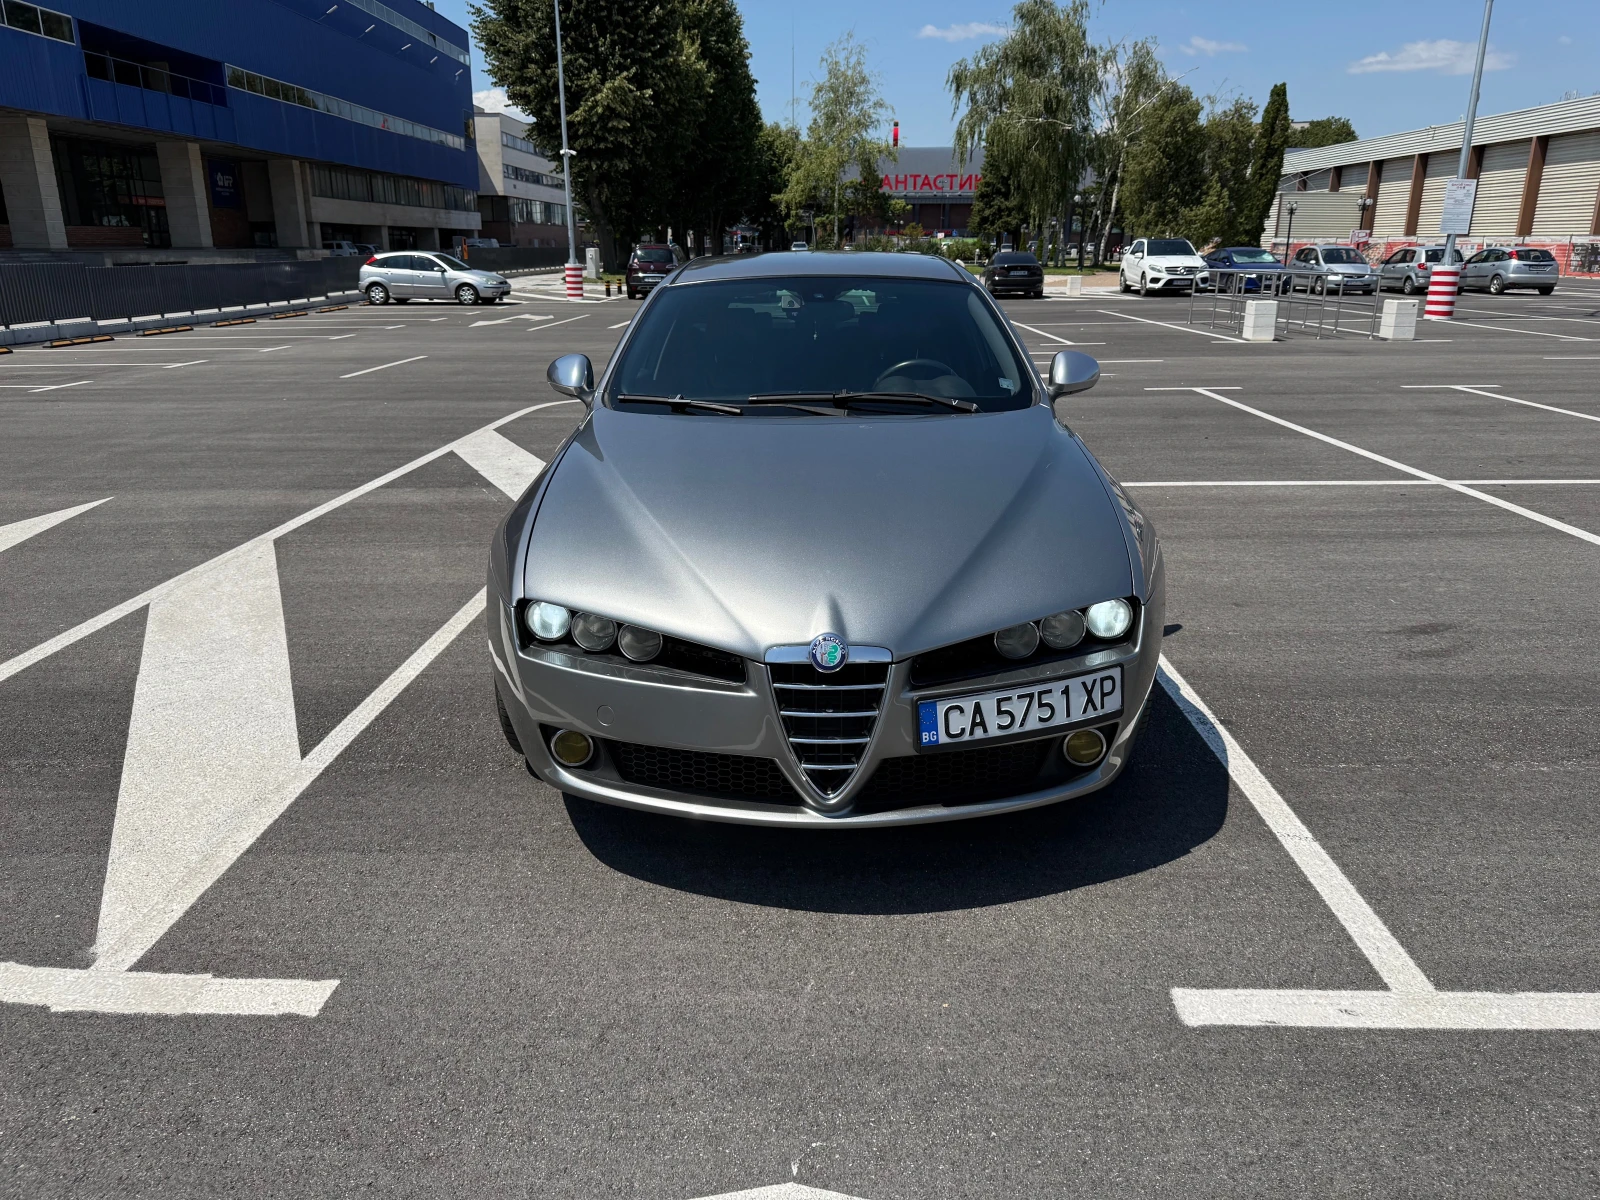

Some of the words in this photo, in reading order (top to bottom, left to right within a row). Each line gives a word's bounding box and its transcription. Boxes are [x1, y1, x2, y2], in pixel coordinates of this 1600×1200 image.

[880, 173, 983, 191] АНТАСТИК
[943, 700, 988, 739] CA
[996, 684, 1071, 730] 5751
[1081, 675, 1116, 715] XP
[922, 731, 937, 743] BG
